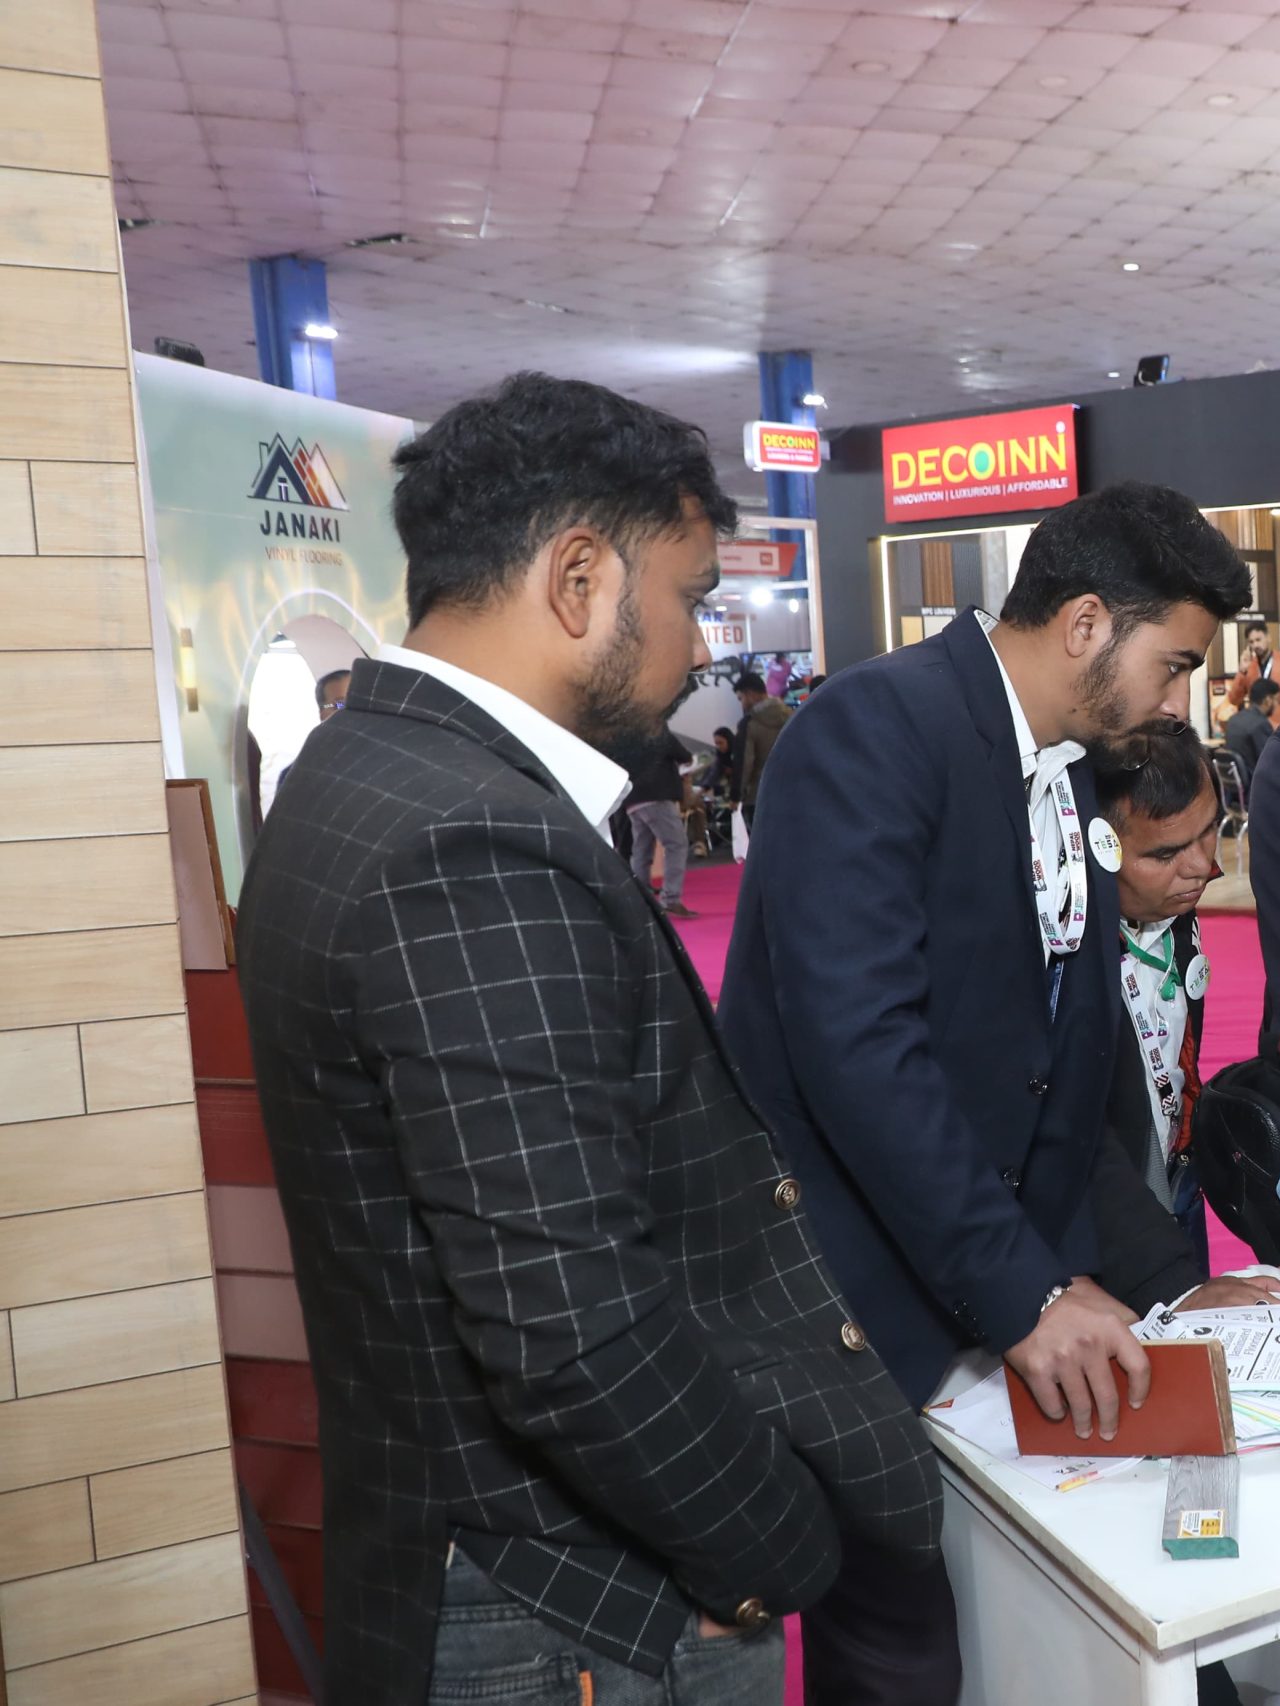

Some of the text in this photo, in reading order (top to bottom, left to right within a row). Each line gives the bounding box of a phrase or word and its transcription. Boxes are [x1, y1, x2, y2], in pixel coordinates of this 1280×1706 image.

[762, 433, 816, 450] DECOINN
[891, 432, 1067, 490] DECOINN
[893, 477, 1068, 506] INNOVATION LUXURIOUS AFFORDABLE
[260, 509, 340, 542] JANAKI
[704, 626, 744, 644] ITED
